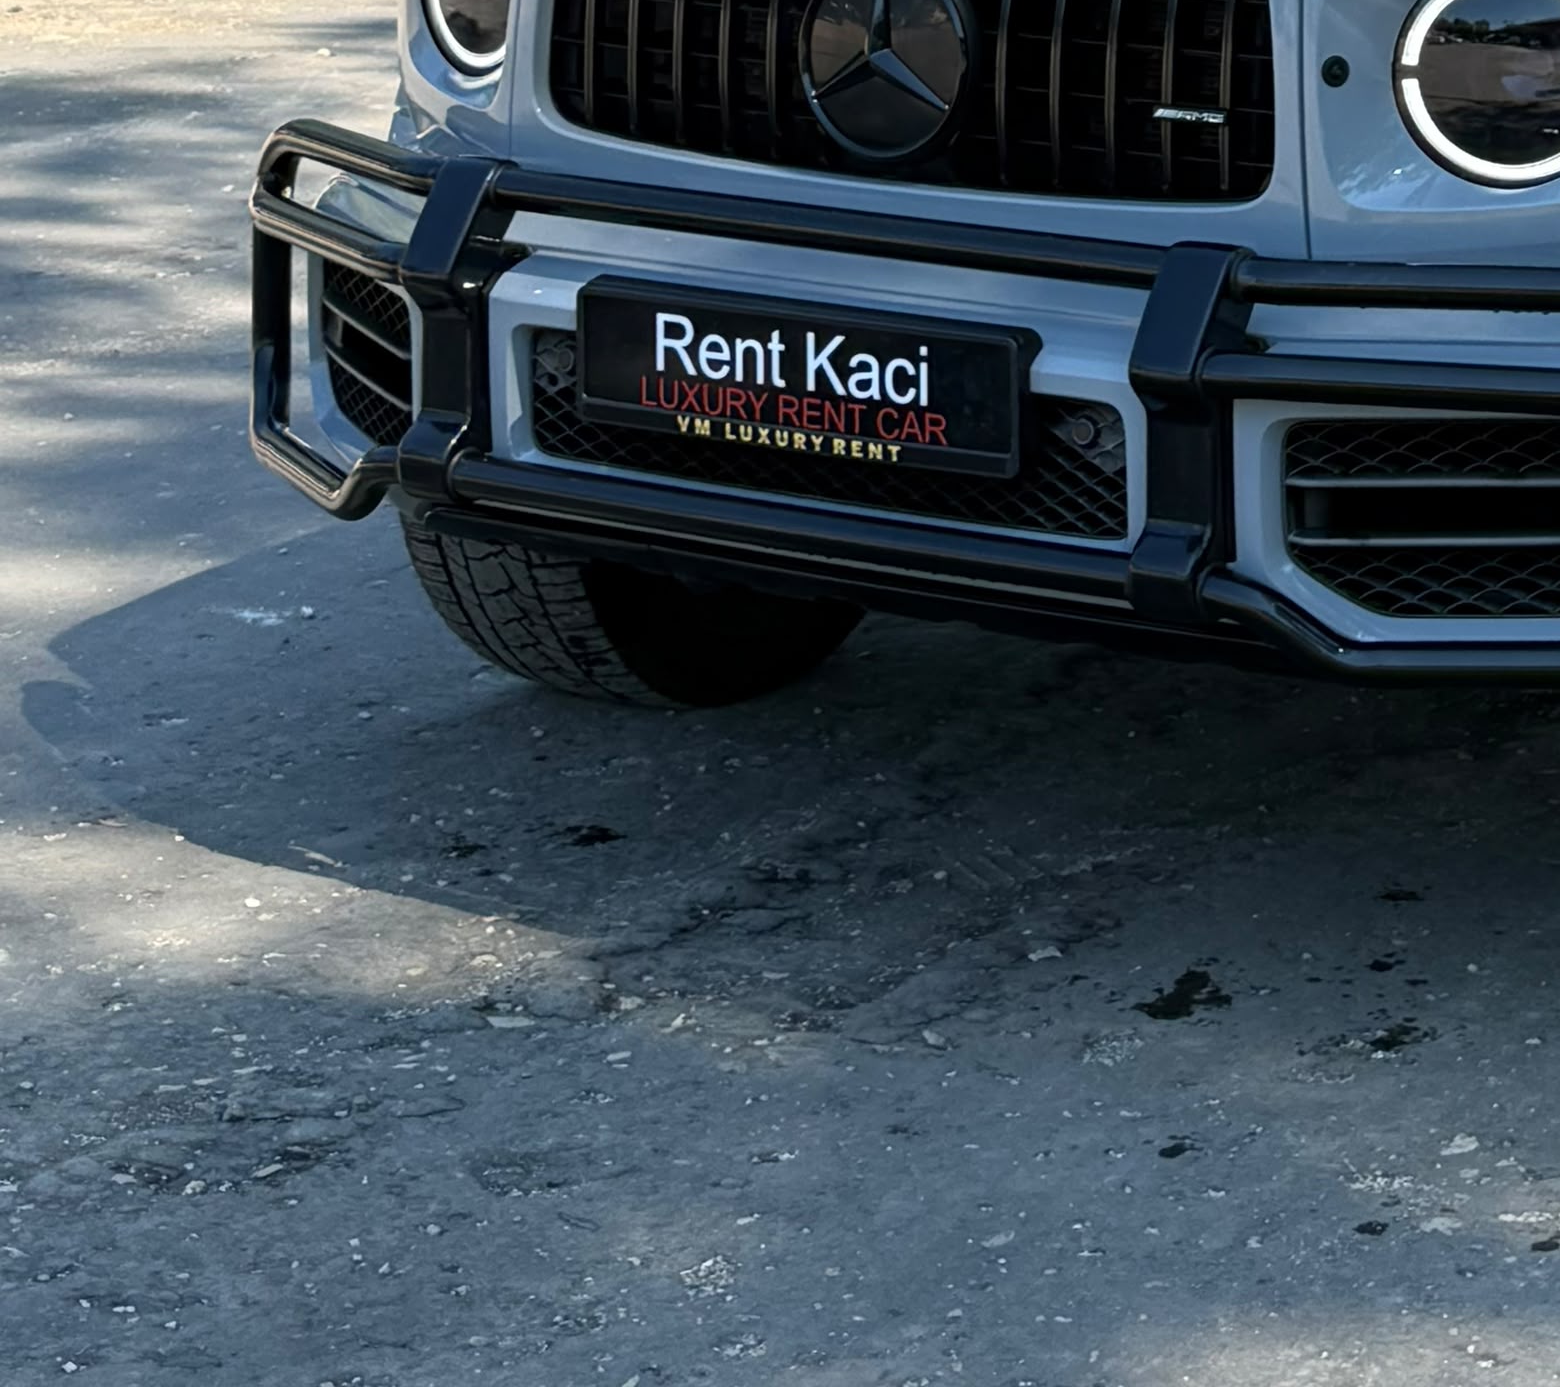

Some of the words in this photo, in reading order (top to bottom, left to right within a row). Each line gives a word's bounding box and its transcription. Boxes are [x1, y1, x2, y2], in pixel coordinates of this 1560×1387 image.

[655, 312, 786, 388] Rent
[806, 331, 929, 407] Kaci
[640, 375, 770, 422] LUXURY
[778, 395, 867, 435] RENT
[876, 407, 948, 446] CAR
[676, 415, 712, 437] VM
[725, 420, 822, 453] LUXURY
[832, 439, 902, 462] RENT
